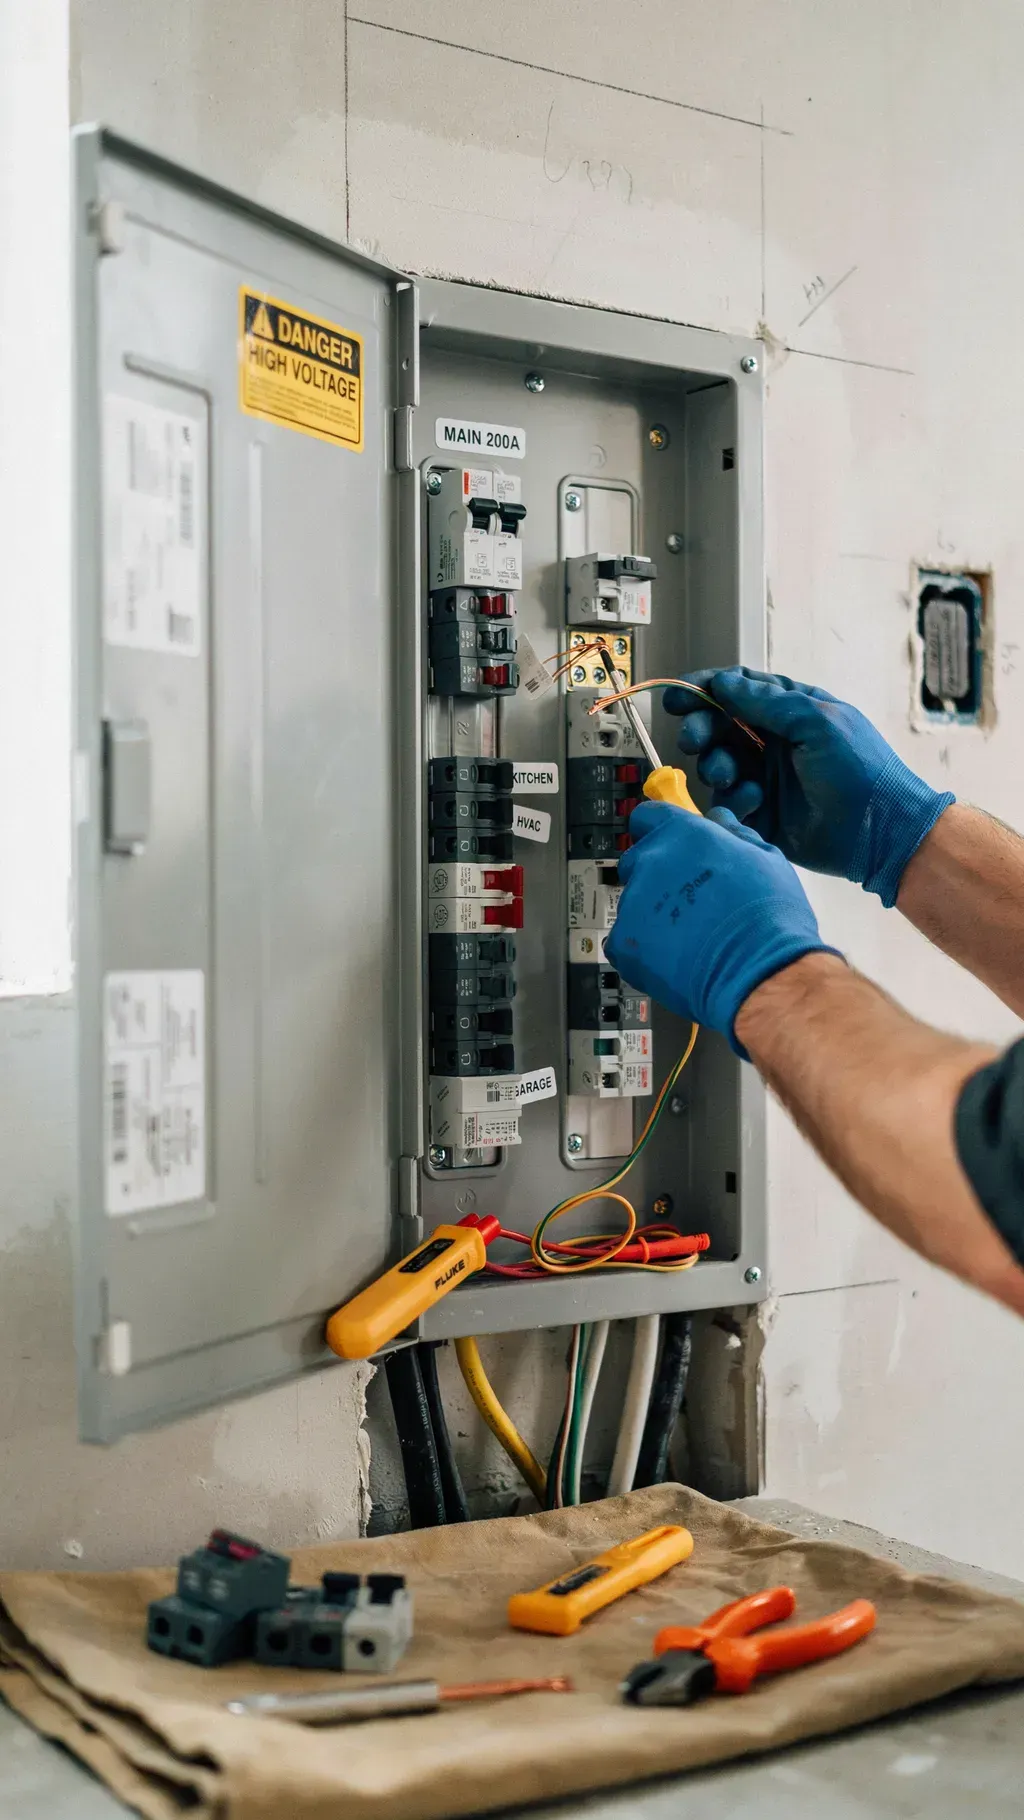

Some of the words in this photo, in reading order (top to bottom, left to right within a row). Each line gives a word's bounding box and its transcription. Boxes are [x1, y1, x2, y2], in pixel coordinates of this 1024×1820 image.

[278, 315, 353, 369] DANGER
[249, 343, 287, 376] HIGH
[292, 358, 357, 402] VOLTAGE
[444, 426, 481, 445] MAIN
[486, 432, 520, 450] 200A
[513, 772, 553, 784] KITCHEN
[517, 816, 541, 832] HVAC
[434, 1259, 466, 1290] FLUKE
